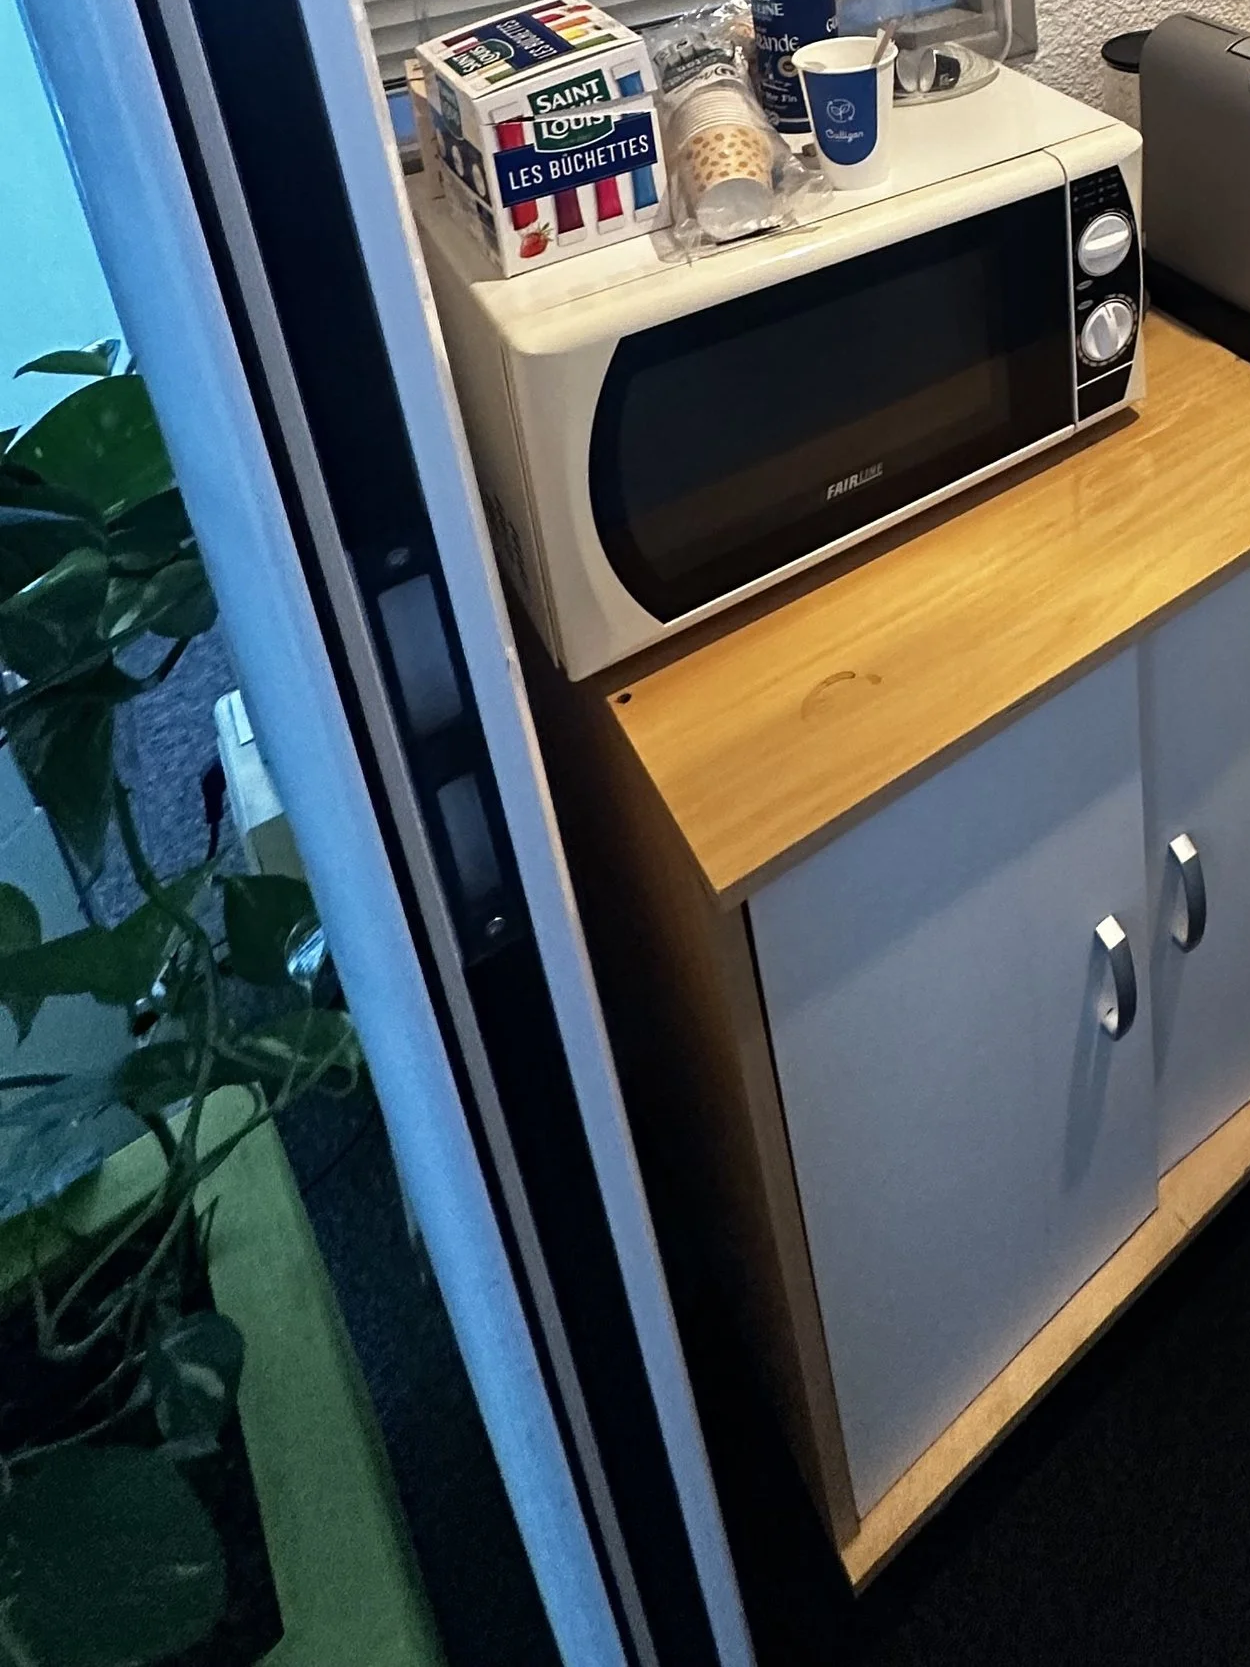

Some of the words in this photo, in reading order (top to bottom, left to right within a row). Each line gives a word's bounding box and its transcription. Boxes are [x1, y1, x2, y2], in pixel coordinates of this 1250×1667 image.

[469, 45, 501, 63] LOUIS
[529, 39, 557, 59] LES
[452, 53, 480, 73] SAINT
[535, 78, 600, 114] SAINT
[540, 96, 606, 139] LOUIS
[825, 127, 864, 143] Culligan
[508, 163, 543, 190] LES
[549, 134, 649, 179] BÛCHETTES
